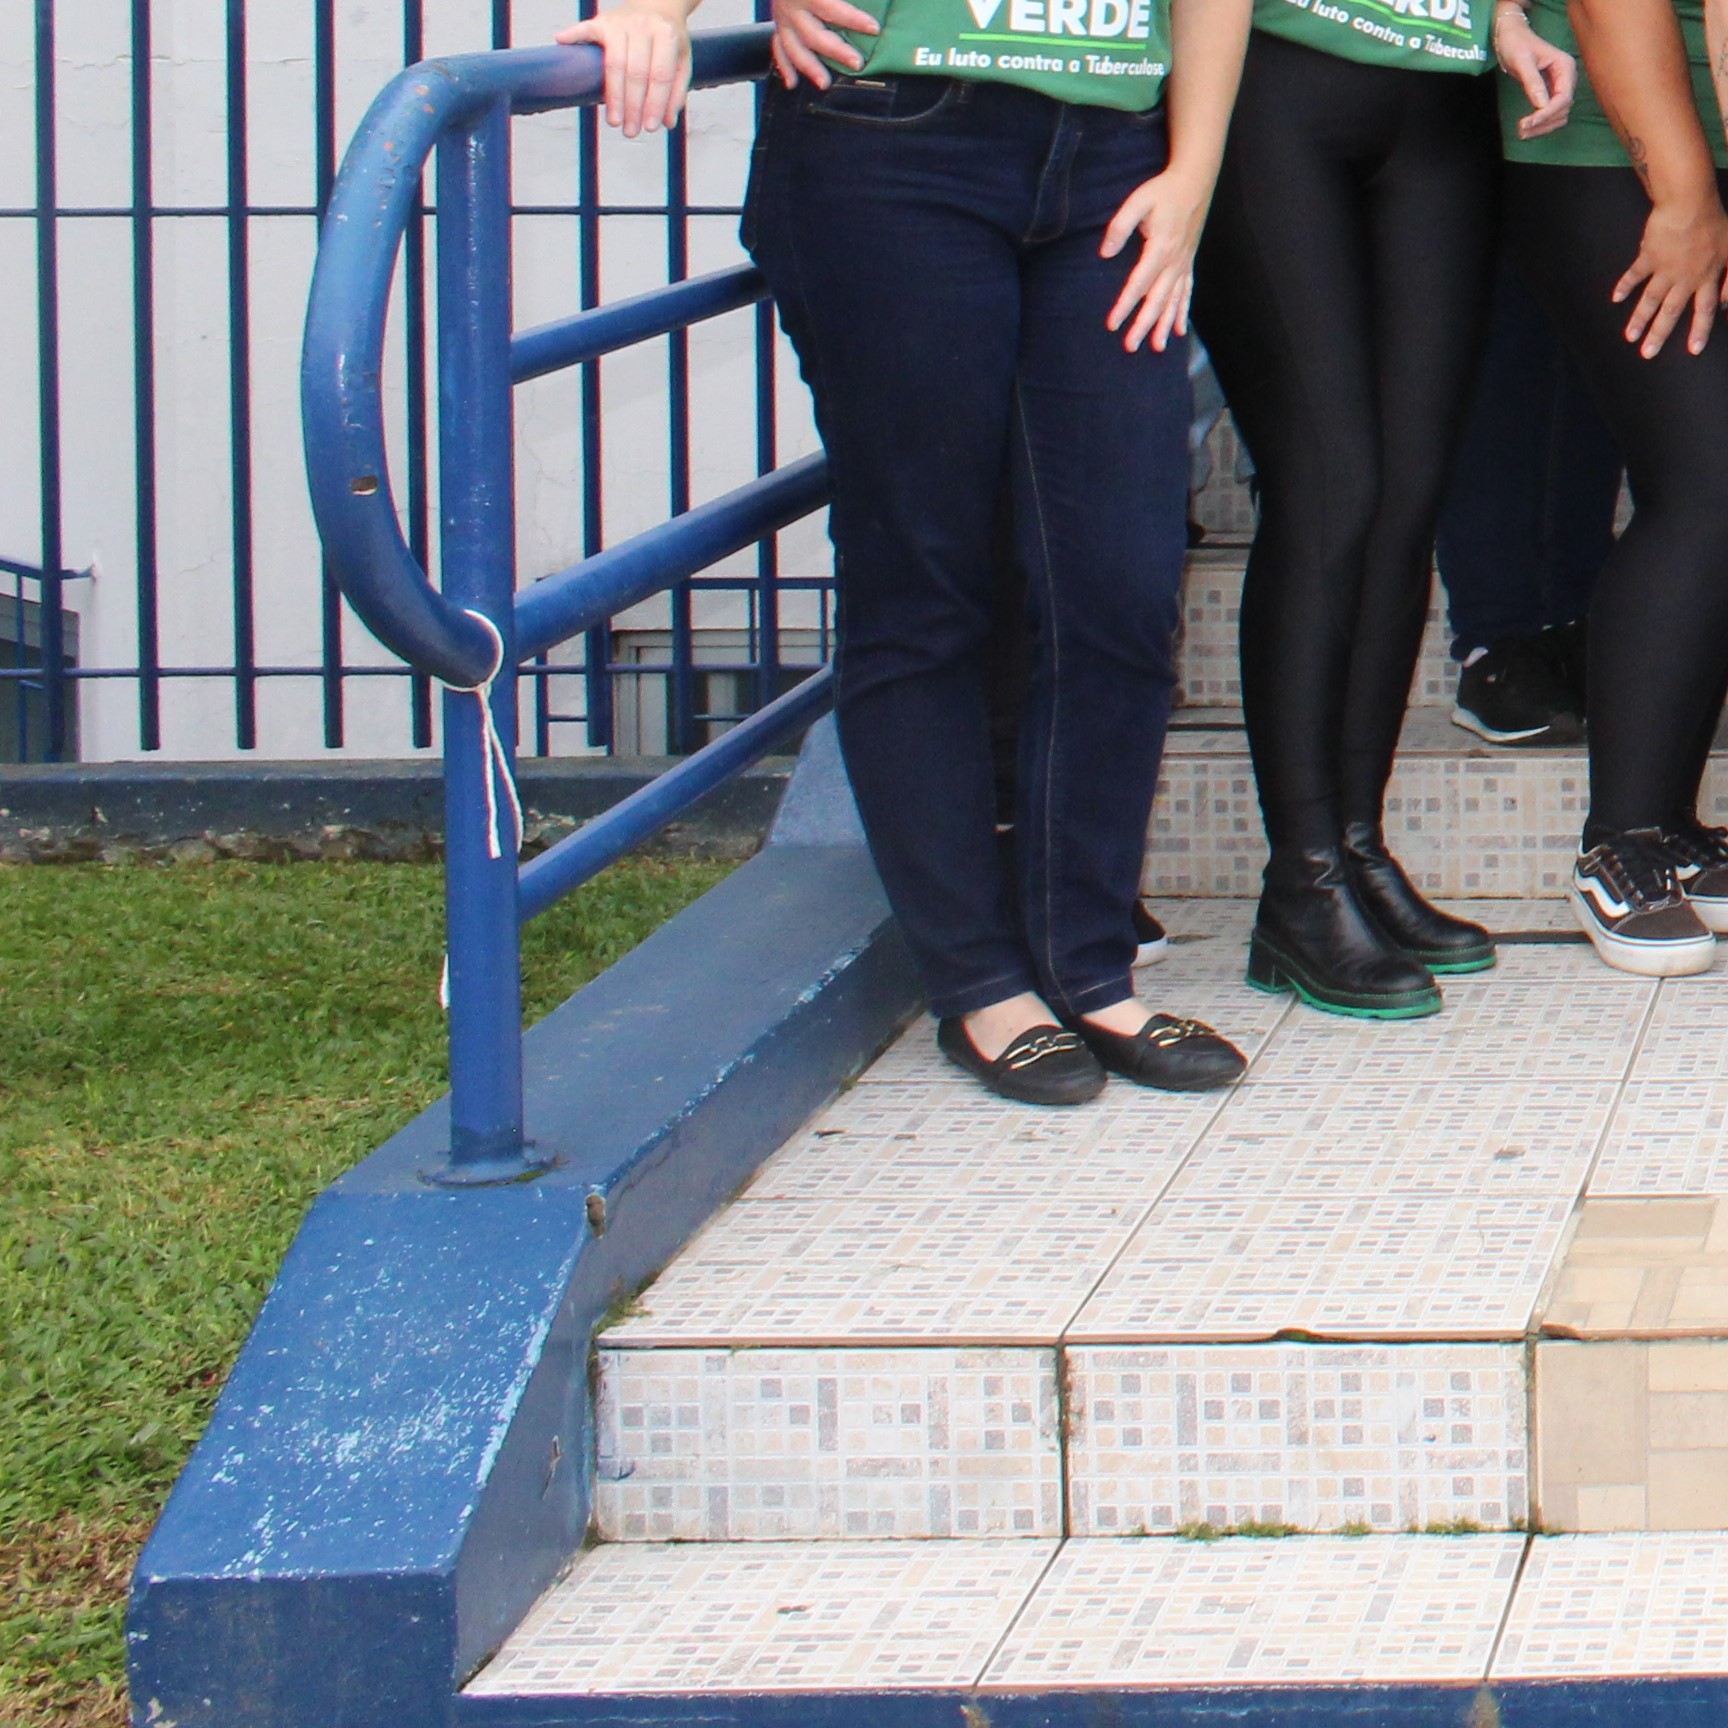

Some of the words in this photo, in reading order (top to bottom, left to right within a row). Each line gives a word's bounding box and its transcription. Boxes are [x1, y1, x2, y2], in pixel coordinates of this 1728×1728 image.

[1352, 16, 1405, 48] contra
[1408, 35, 1422, 49] a
[914, 47, 942, 67] Eu
[947, 48, 991, 68] luto
[997, 53, 1064, 73] contra
[1069, 60, 1080, 73] a
[1085, 54, 1166, 76] Tuberculose
